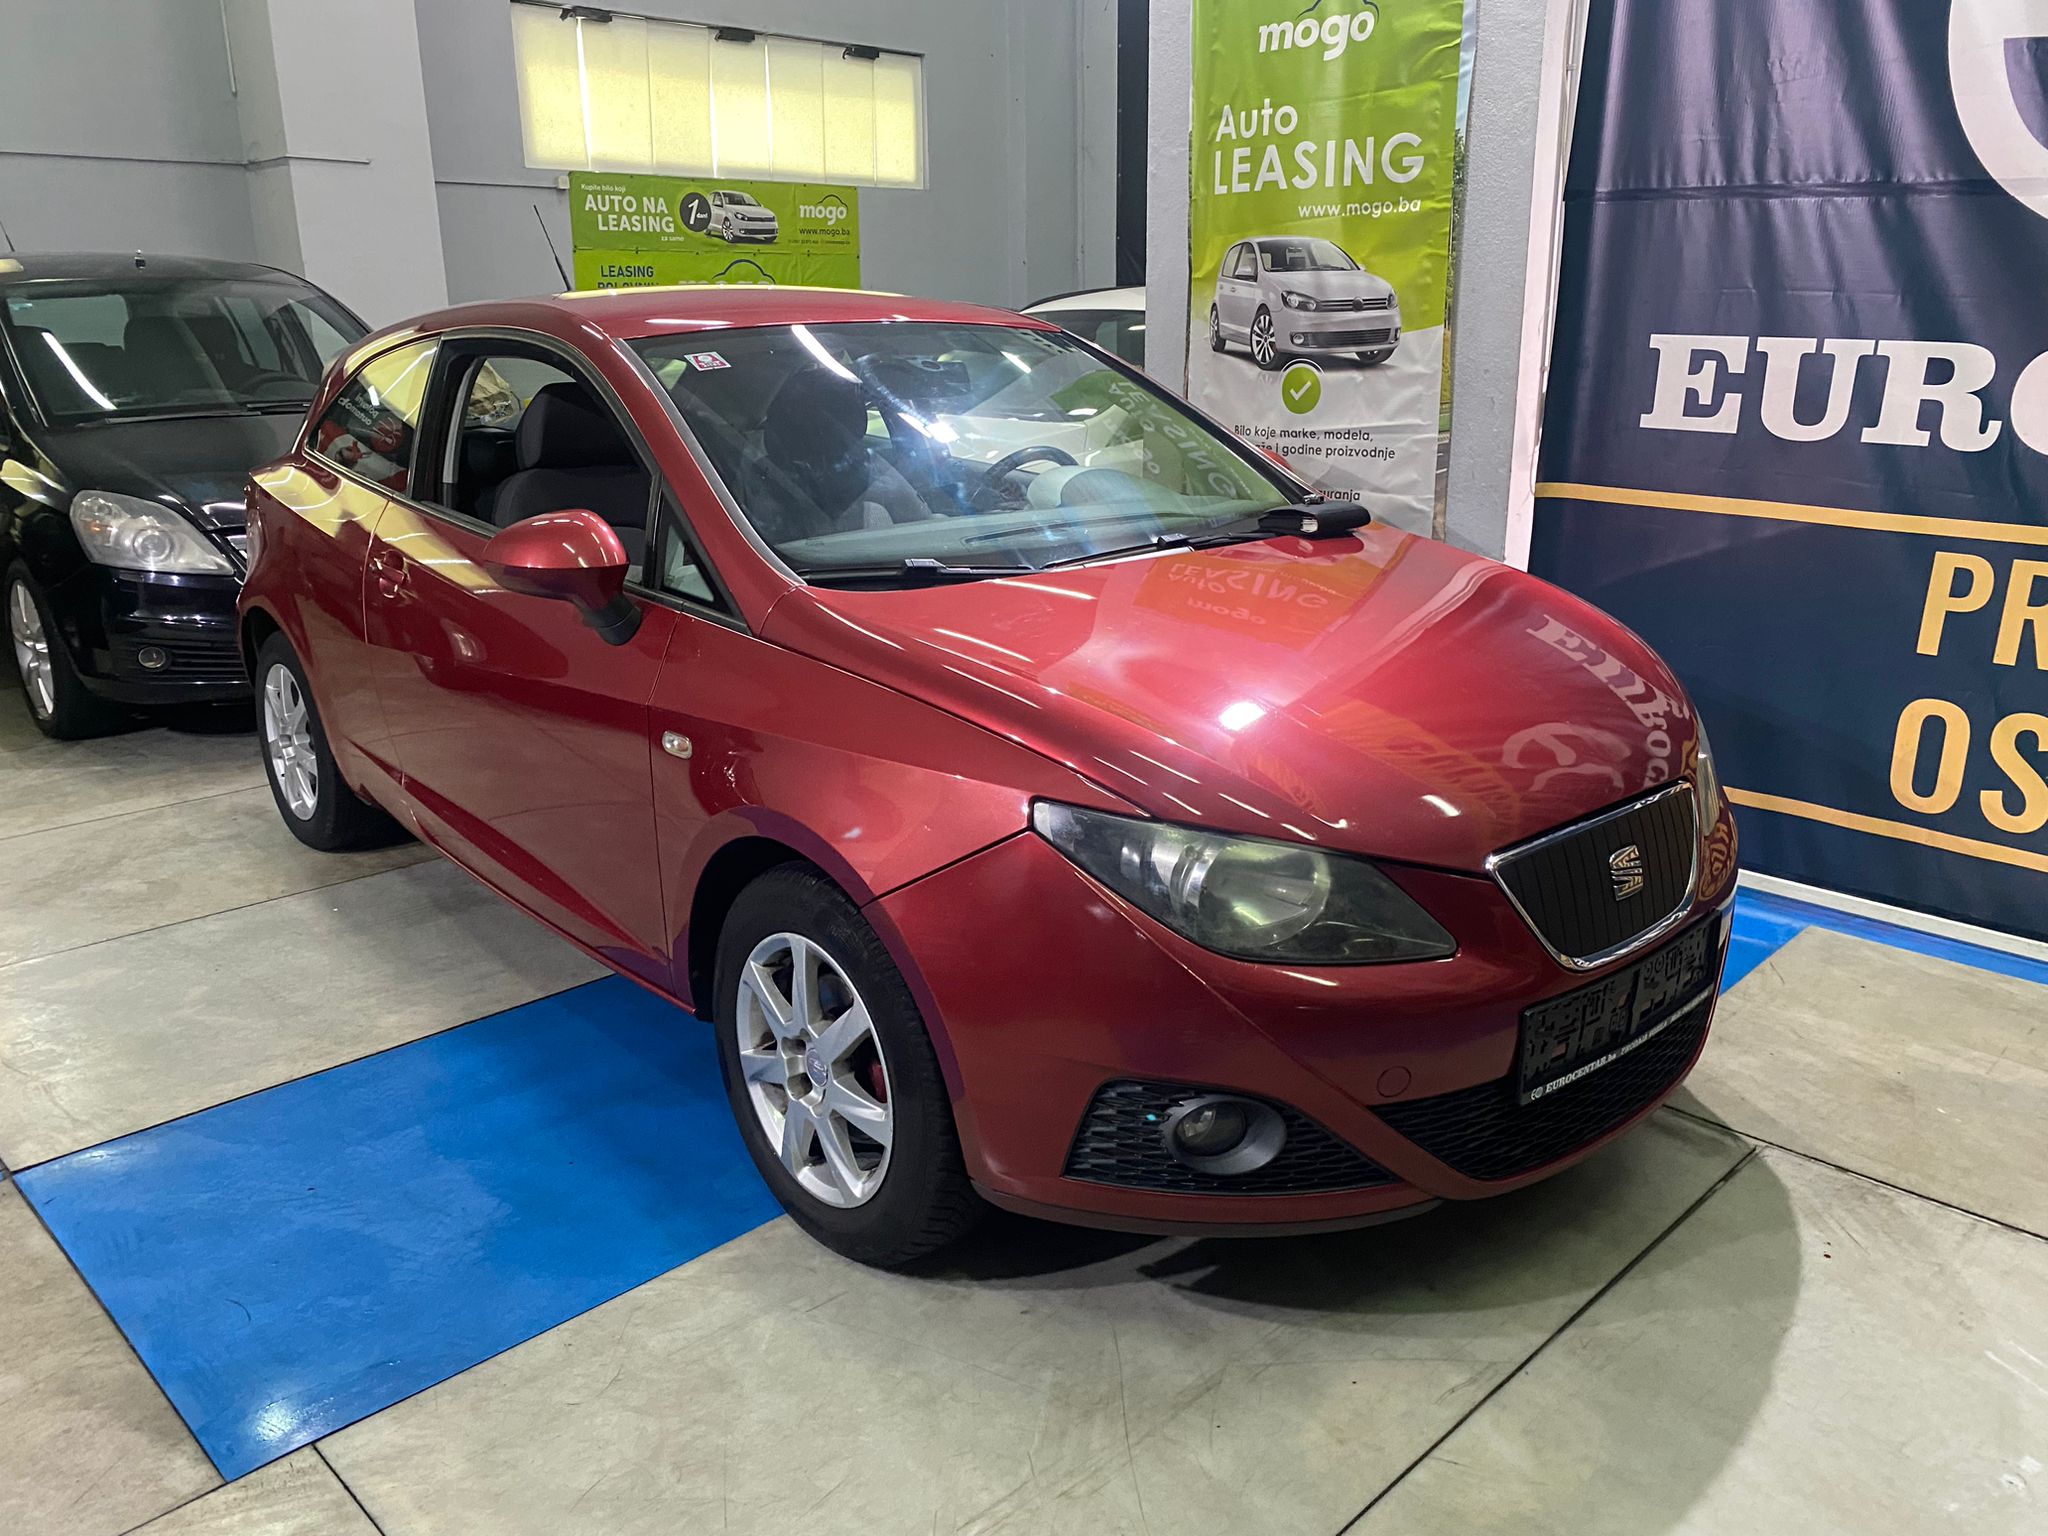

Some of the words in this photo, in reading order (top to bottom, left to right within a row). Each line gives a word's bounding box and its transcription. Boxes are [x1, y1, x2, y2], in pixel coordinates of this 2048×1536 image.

[1259, 11, 1375, 61] mogo
[1215, 97, 1298, 142] Auto
[1214, 132, 1425, 196] LEASING
[584, 194, 637, 213] AUTO
[642, 196, 669, 214] NA
[1298, 197, 1422, 219] www.mogo.ba
[597, 214, 675, 233] LEASING
[799, 204, 847, 226] mogo
[799, 228, 851, 237] www.mogo.ba
[600, 265, 654, 278] LEASING
[1254, 425, 1277, 440] koje
[1280, 427, 1320, 440] marke,
[1324, 429, 1373, 442] modela,
[1282, 443, 1322, 457] godine
[1325, 445, 1396, 461] proizvodnje
